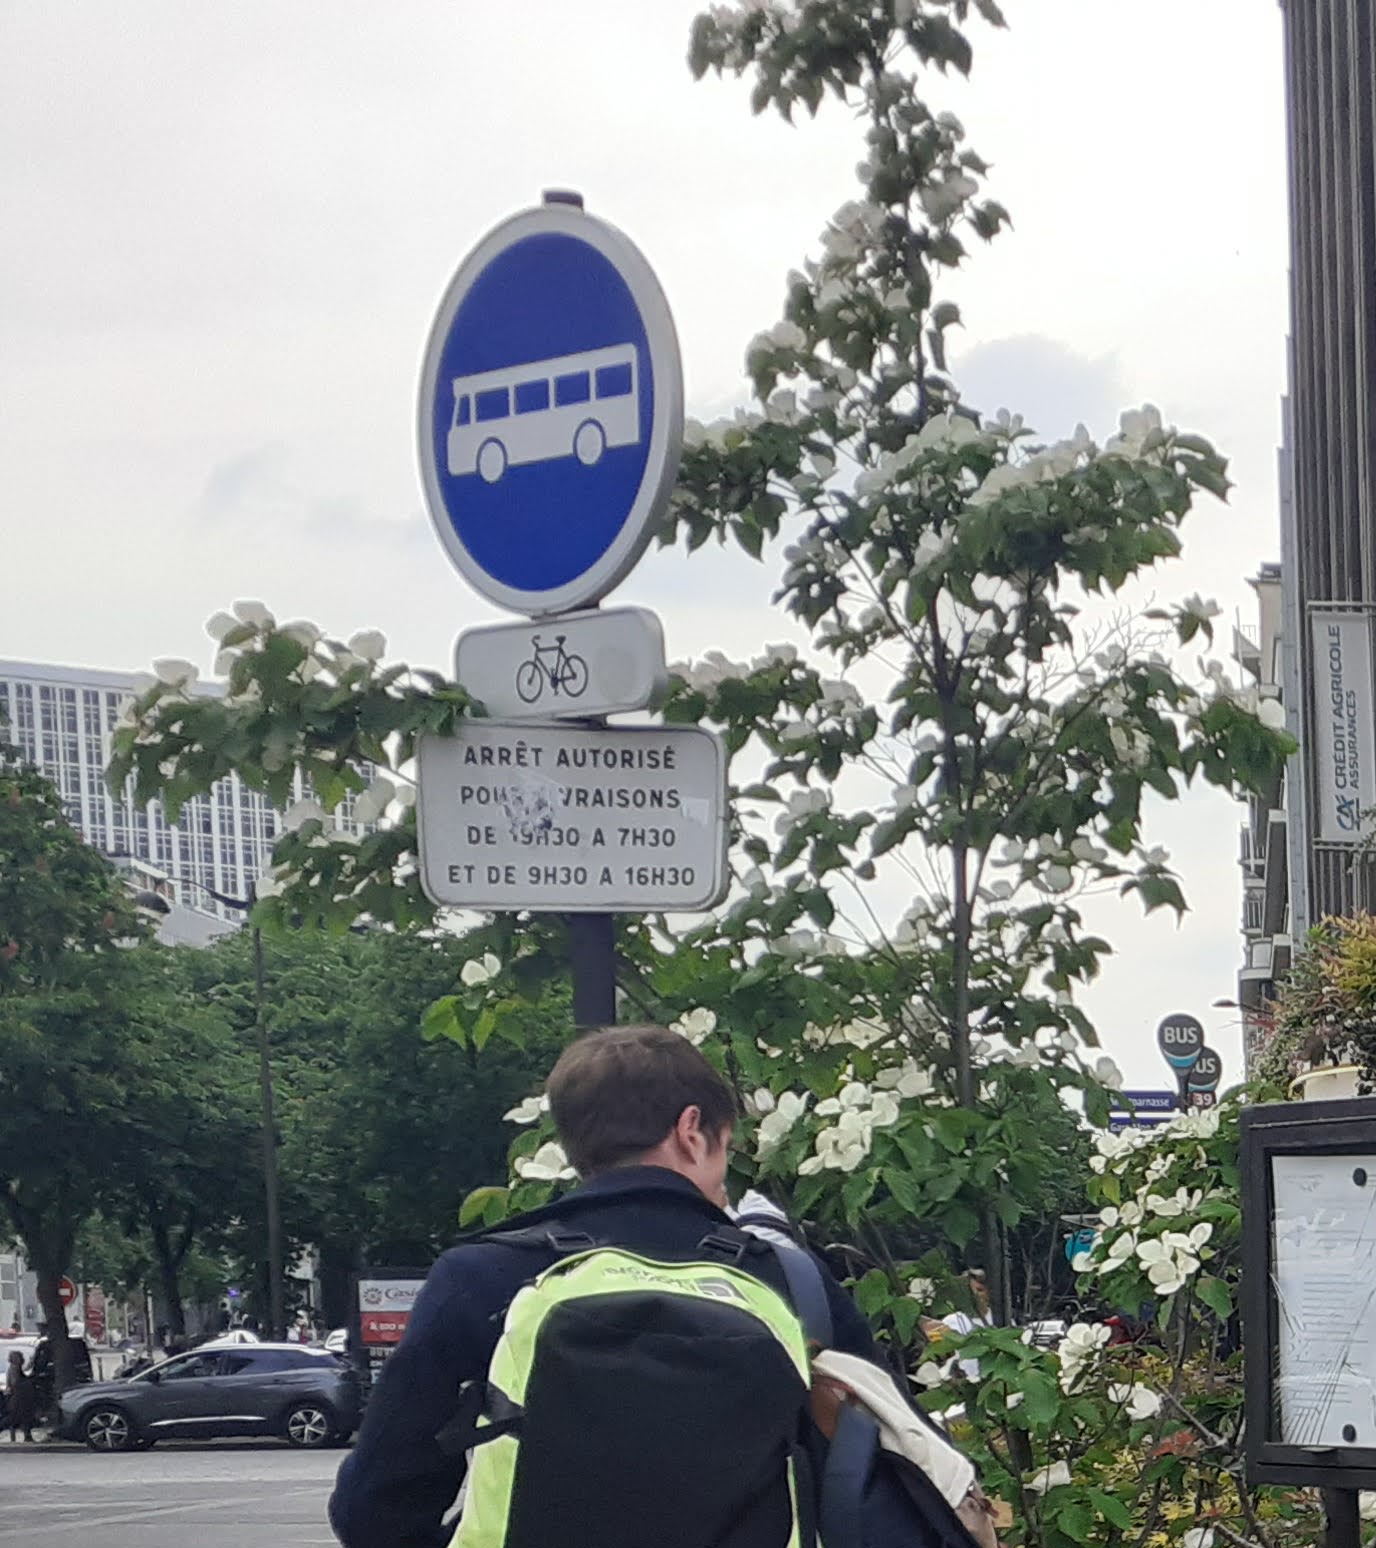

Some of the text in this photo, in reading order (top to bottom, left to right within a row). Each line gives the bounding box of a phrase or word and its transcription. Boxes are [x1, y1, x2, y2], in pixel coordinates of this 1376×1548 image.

[1327, 624, 1345, 719] AGRICOLE
[1345, 689, 1360, 790] ASSURANCES
[464, 740, 676, 769] ARRÊT AUTORISÉ
[467, 825, 497, 846] DE
[592, 828, 606, 847] A
[617, 828, 676, 847] 7H30
[447, 865, 695, 887] ET DE 9H30 A 16H30
[1163, 1026, 1198, 1044] BUS
[1192, 1057, 1216, 1074] US
[1195, 1093, 1213, 1106] 39
